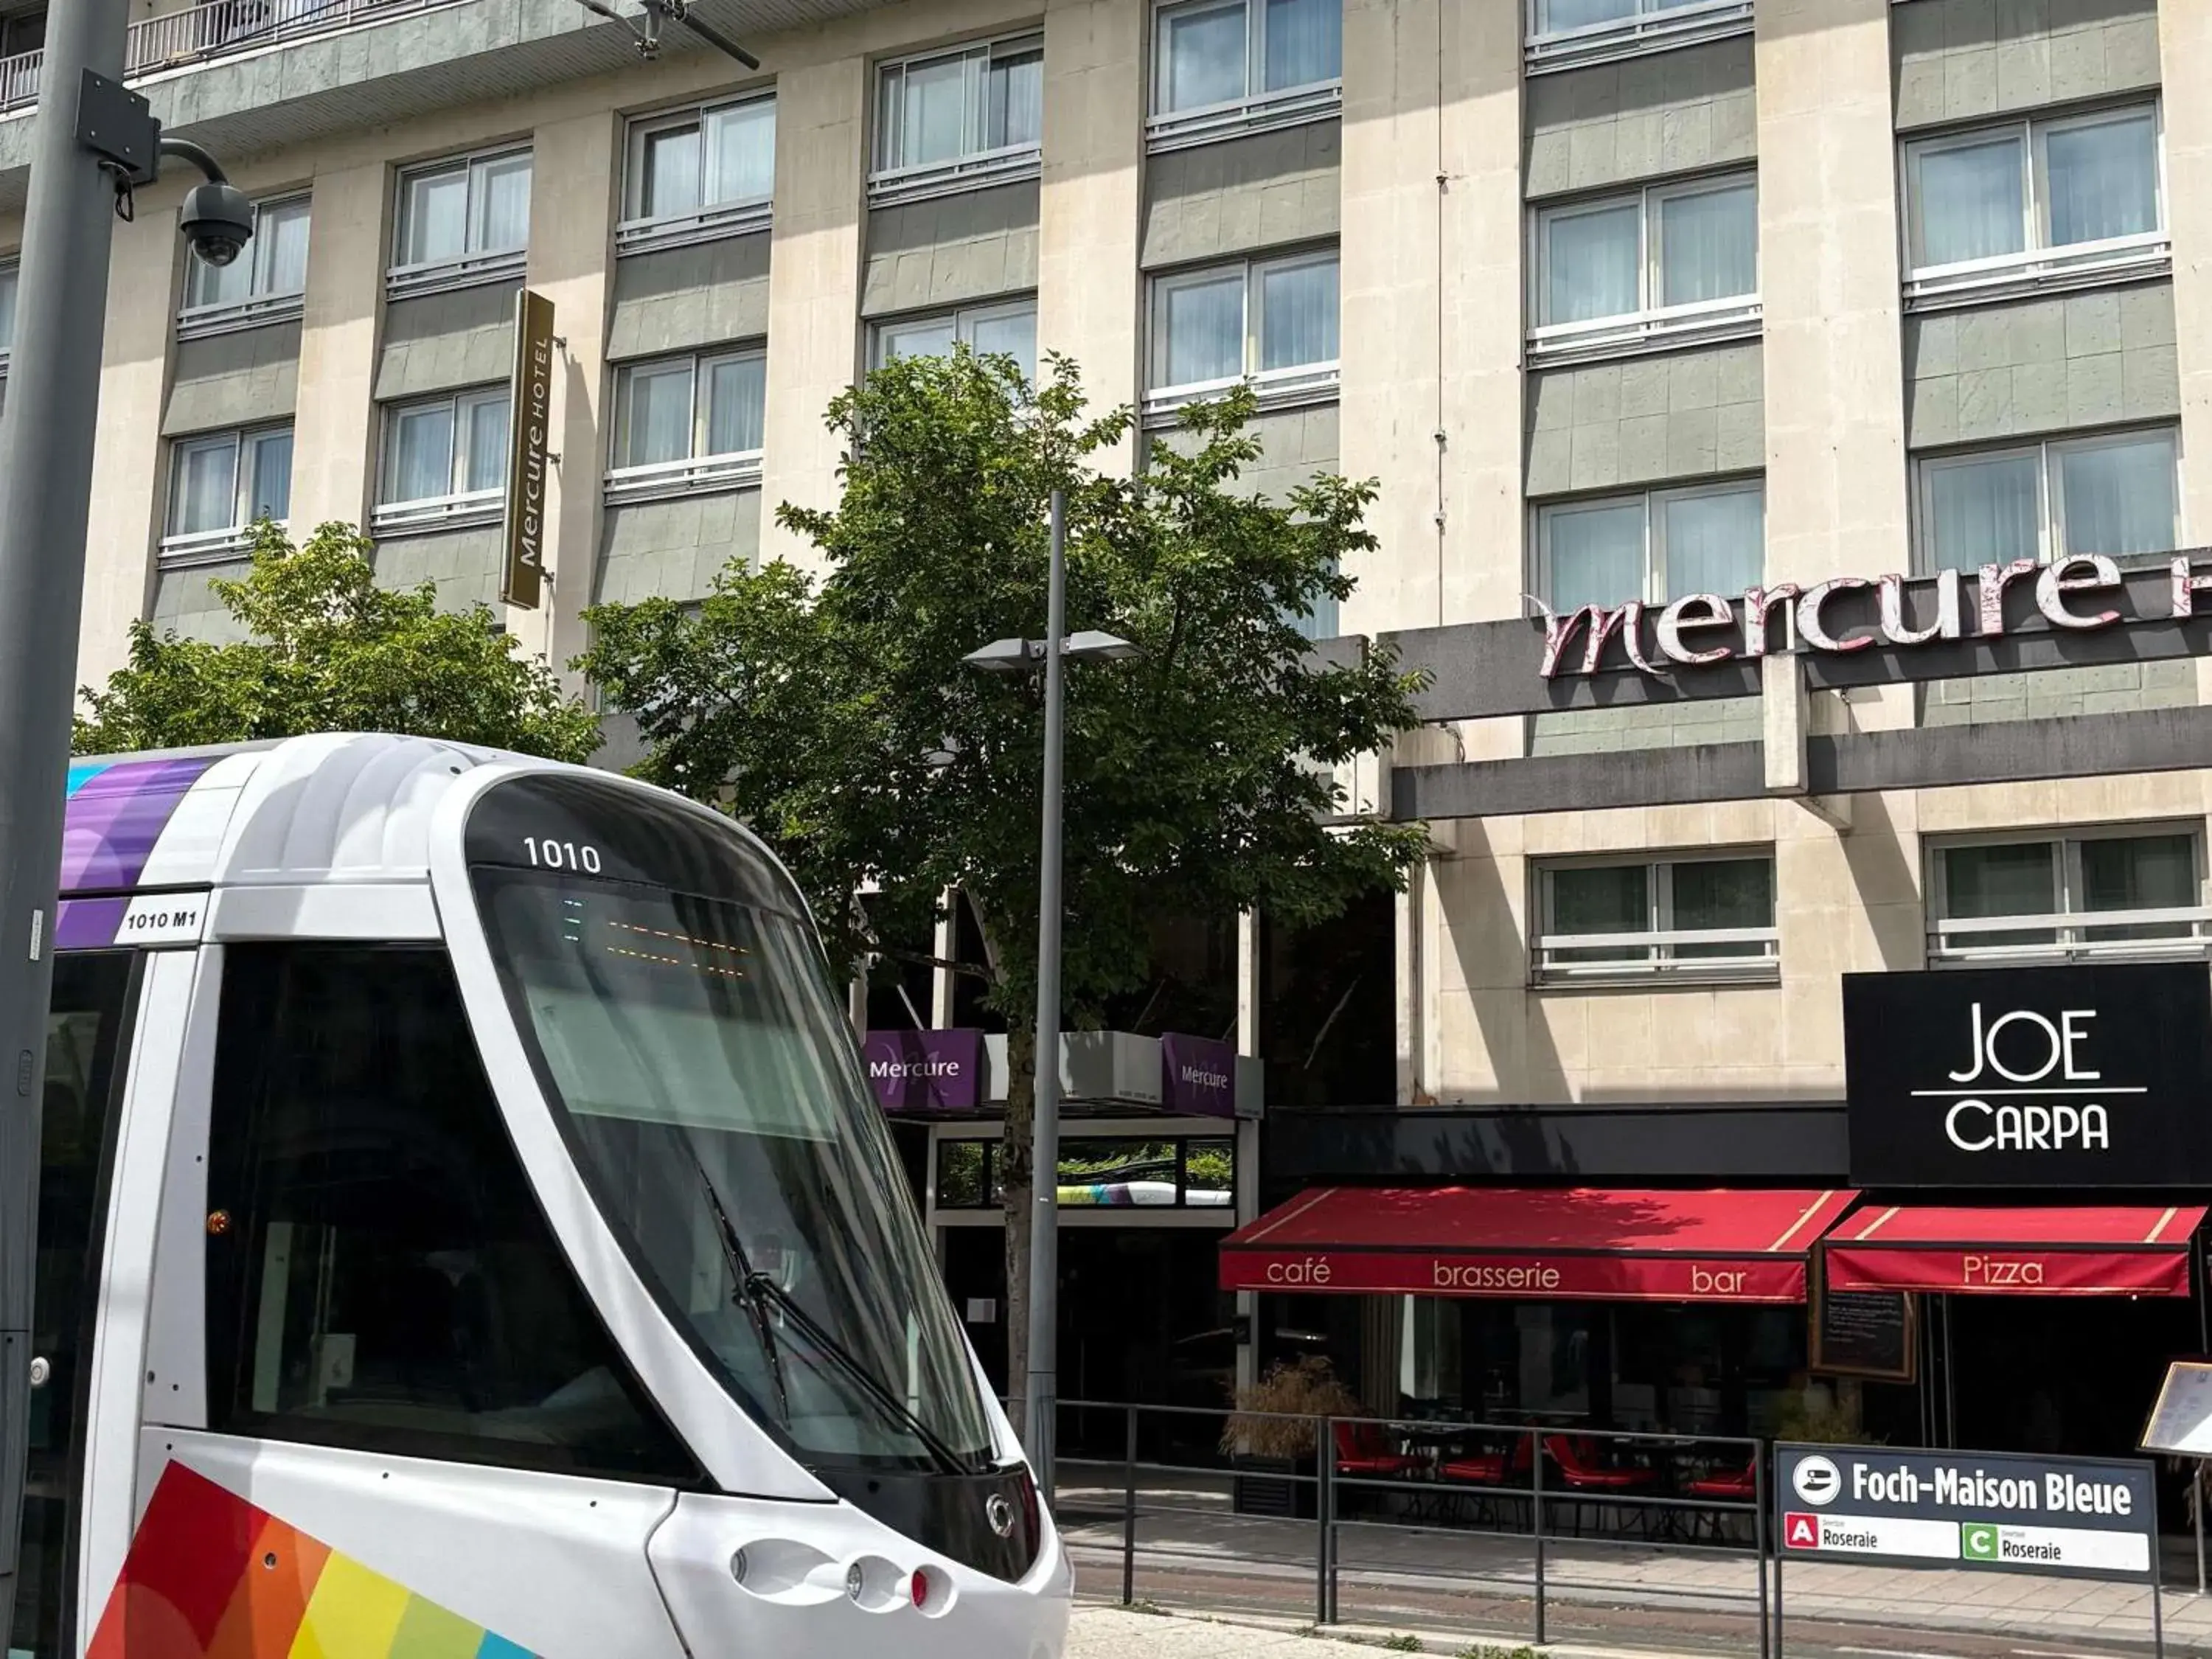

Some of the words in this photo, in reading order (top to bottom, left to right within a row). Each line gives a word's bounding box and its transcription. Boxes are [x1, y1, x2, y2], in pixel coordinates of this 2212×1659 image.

[521, 426, 543, 567] Mercure
[532, 337, 548, 419] HOTEL
[524, 837, 601, 873] 1010
[127, 913, 168, 930] 1010
[173, 911, 197, 927] M1
[1948, 1002, 2101, 1082] JOE
[869, 1060, 959, 1078] Mercure
[1181, 1064, 1228, 1090] Mercure
[1267, 1257, 1331, 1284] café
[1433, 1261, 1560, 1289] brasserie
[1691, 1265, 1746, 1294] bar
[1963, 1256, 2044, 1284] Pizza
[1852, 1462, 2038, 1510] Foch-Maison
[2045, 1472, 2132, 1515] Bleue
[1792, 1519, 1815, 1543] A
[1823, 1528, 1878, 1548] Roseraie
[1970, 1530, 1991, 1554] C
[2003, 1540, 2062, 1560] Roseraie
